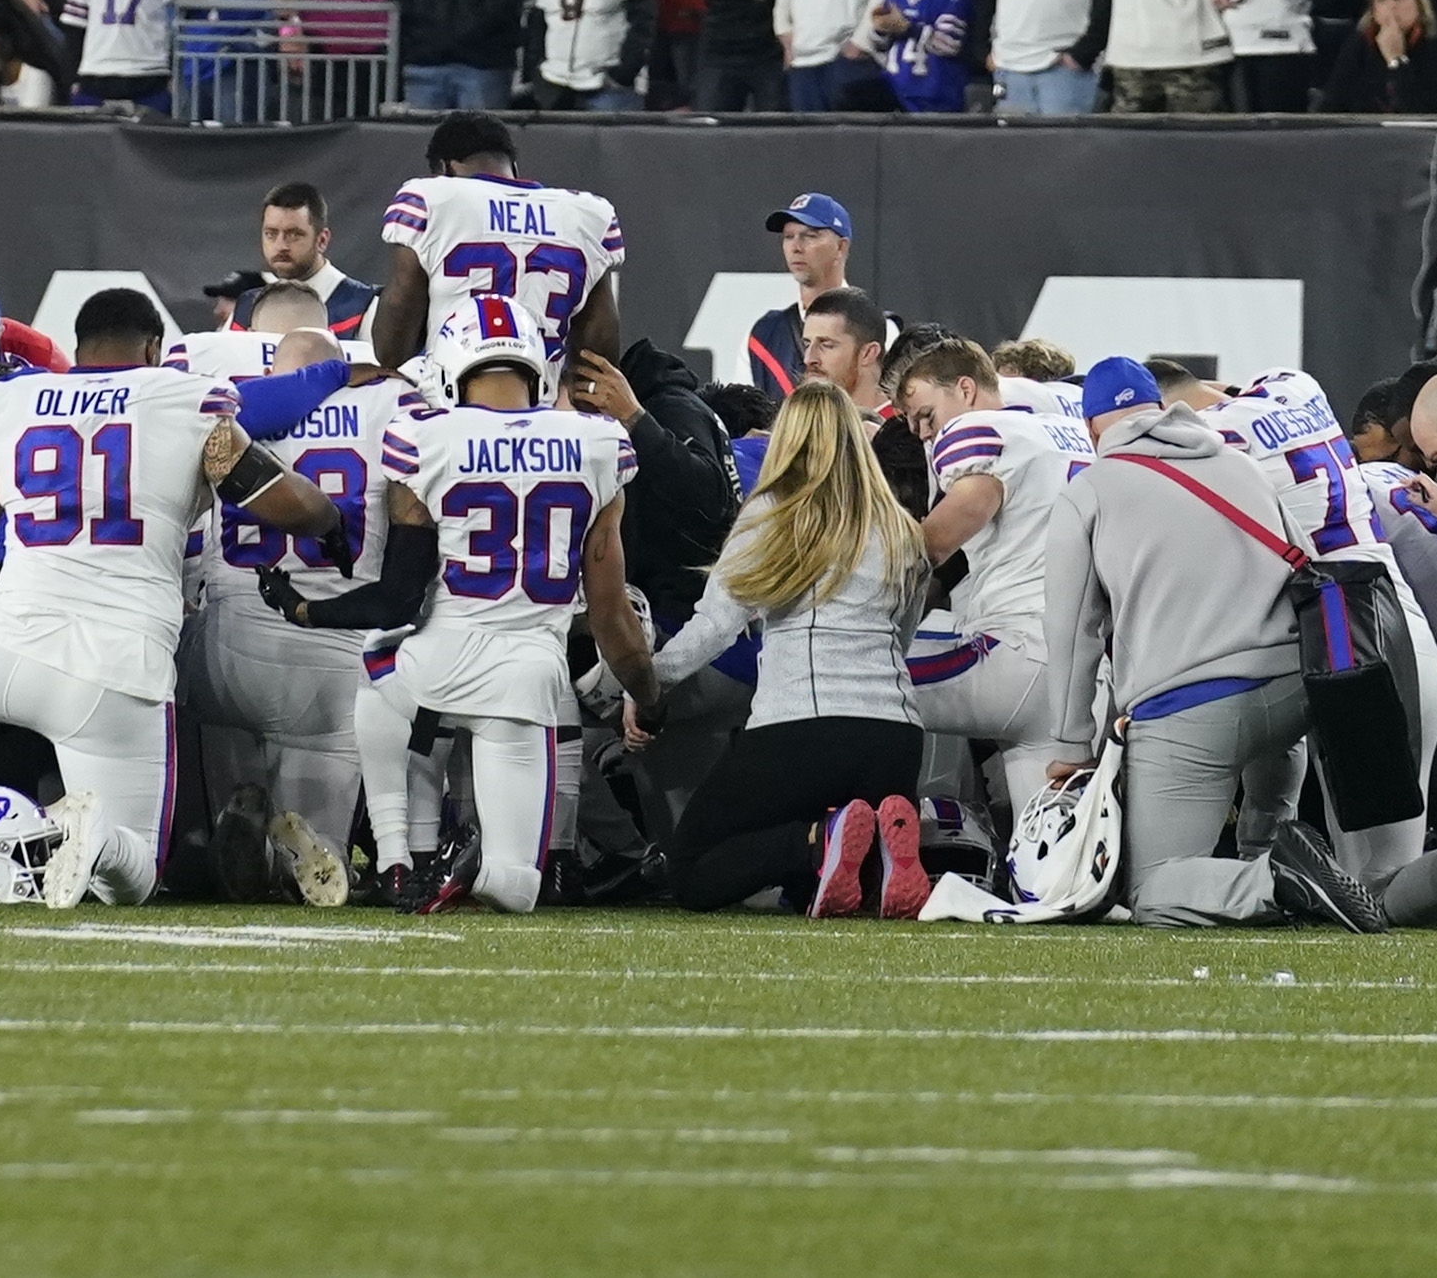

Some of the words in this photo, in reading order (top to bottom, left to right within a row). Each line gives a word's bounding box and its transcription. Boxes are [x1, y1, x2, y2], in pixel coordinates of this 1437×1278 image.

[489, 199, 557, 237] NEAL
[35, 386, 130, 417] OLIVER
[458, 437, 583, 474] JACKSON
[1049, 424, 1094, 455] BASS
[14, 423, 144, 547] 91
[441, 481, 594, 604] 30
